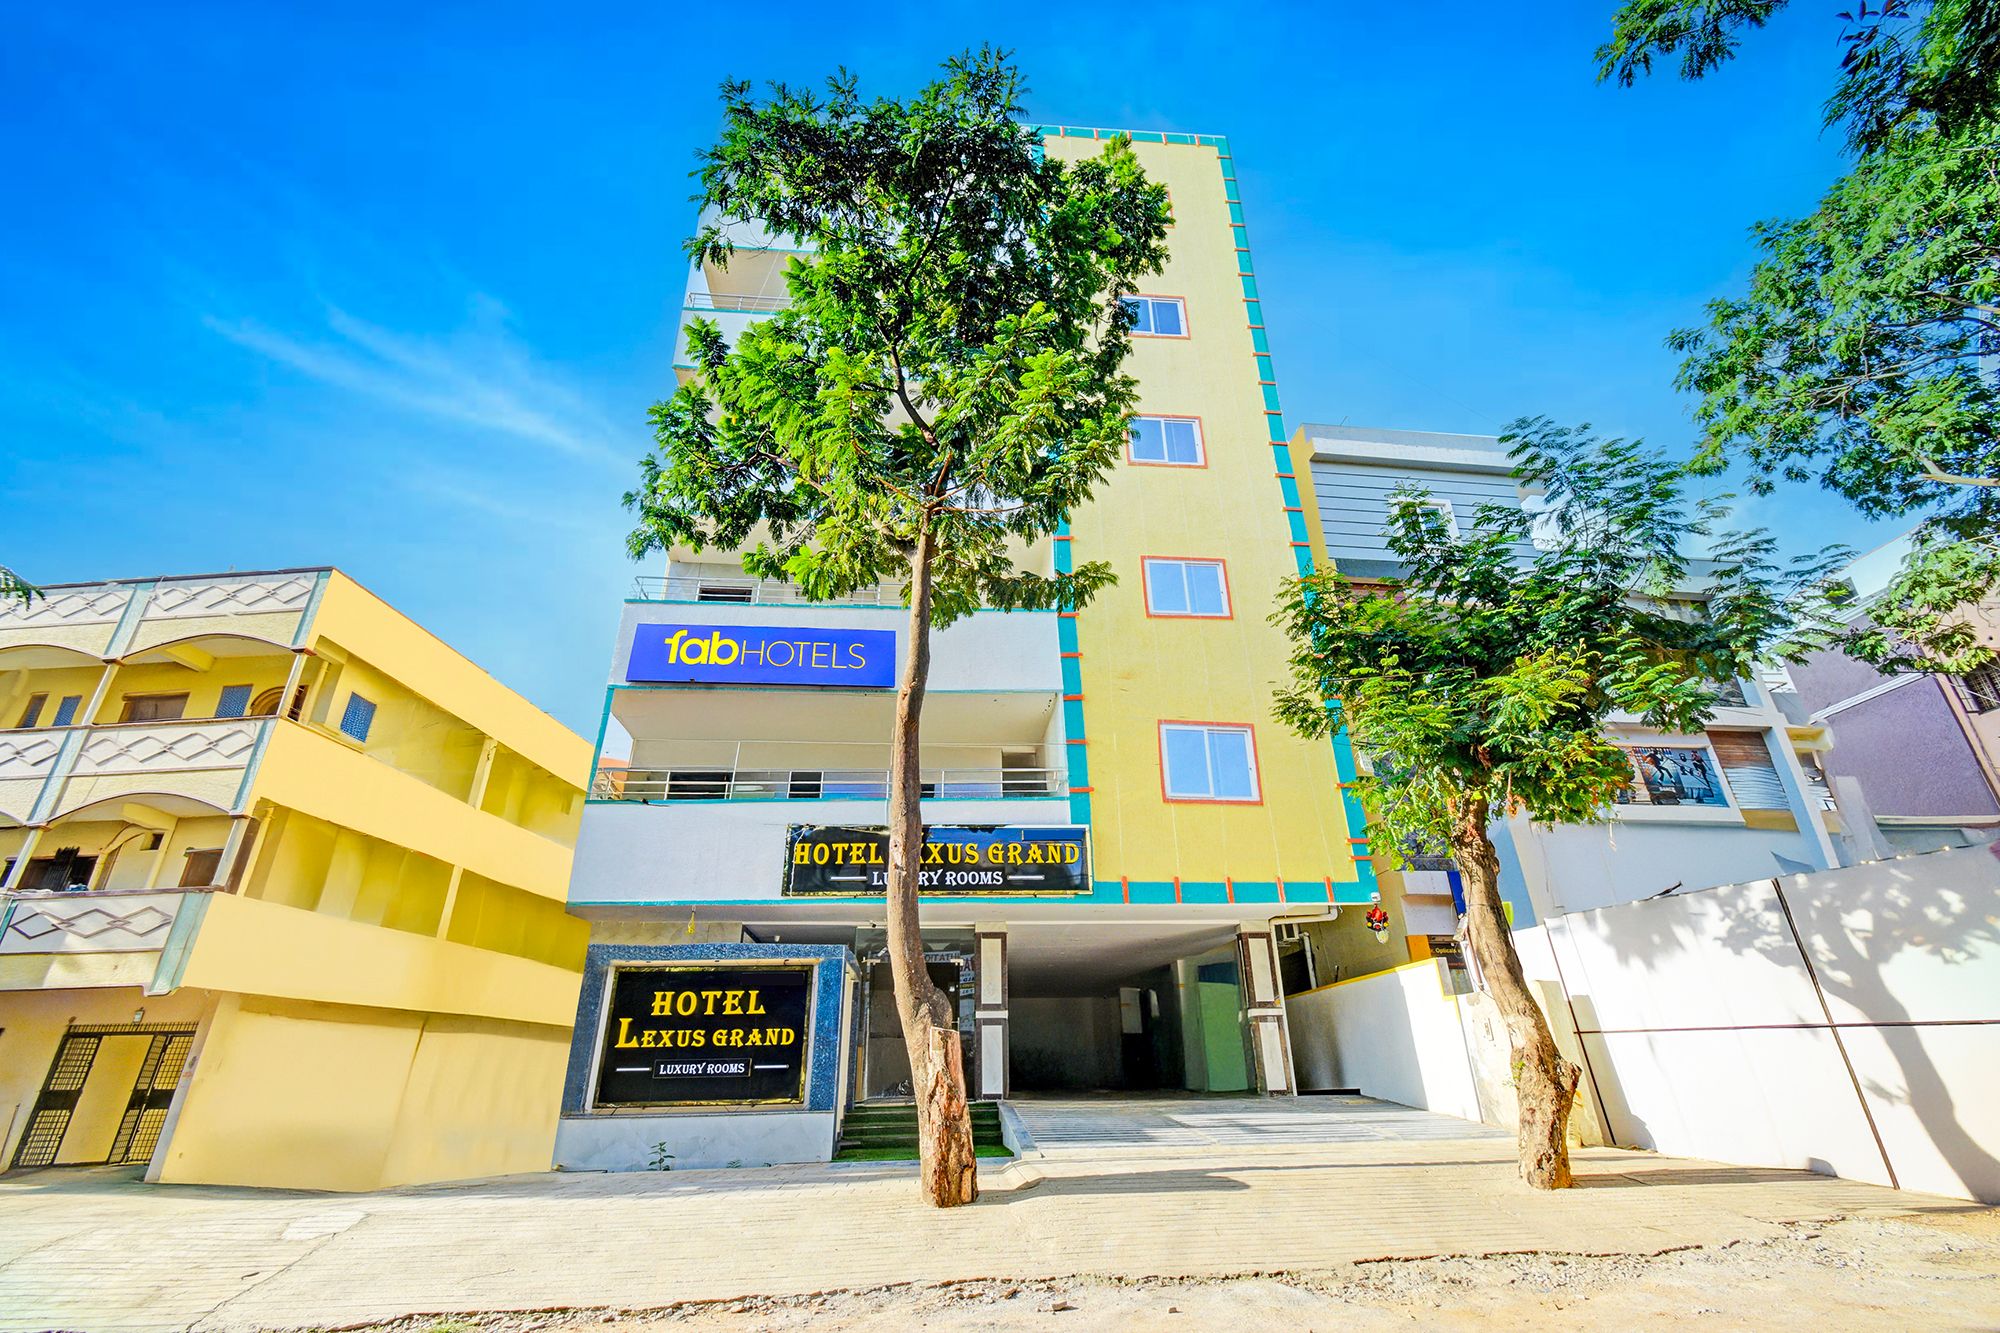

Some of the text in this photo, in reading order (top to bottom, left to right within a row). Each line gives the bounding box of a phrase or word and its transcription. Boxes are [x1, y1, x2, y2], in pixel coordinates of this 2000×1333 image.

[664, 629, 866, 669] fabHOTELS
[793, 842, 884, 865] HOTEL
[988, 842, 1080, 866] GRAND
[945, 871, 1004, 886] ROOMS
[651, 990, 767, 1016] HOTEL
[614, 1018, 795, 1048] LEXUS GRAND
[659, 1061, 746, 1075] LUXURY ROOMS
